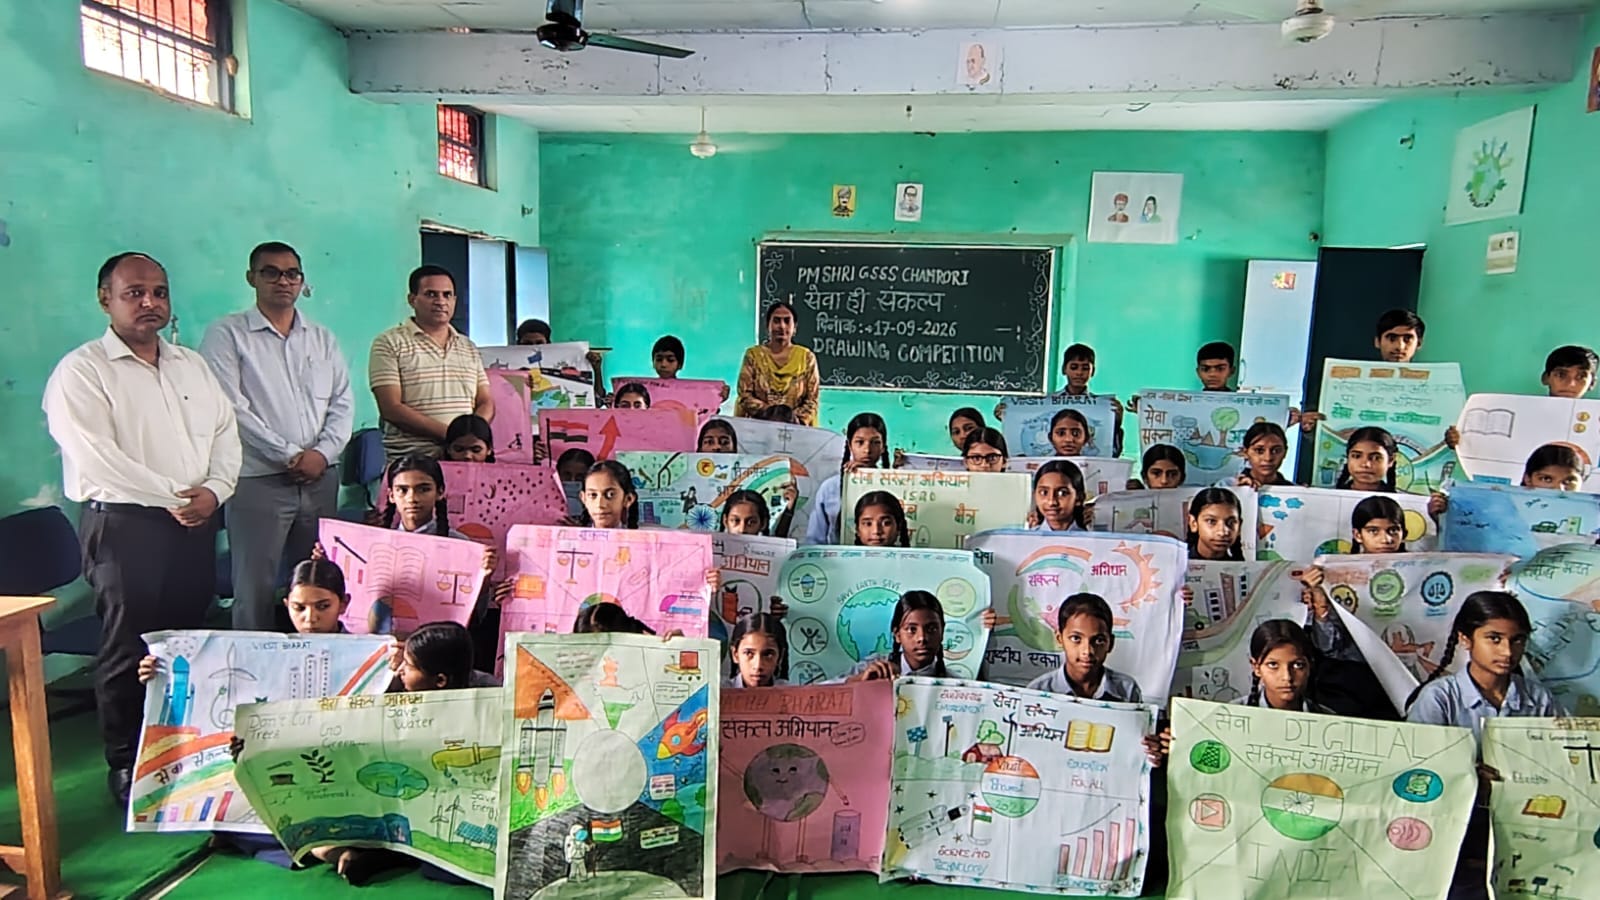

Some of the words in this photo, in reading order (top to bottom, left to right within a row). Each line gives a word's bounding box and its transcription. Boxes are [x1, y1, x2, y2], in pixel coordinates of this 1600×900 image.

[797, 267, 820, 283] PM
[822, 265, 855, 283] SHRI
[858, 265, 899, 282] GSSS
[804, 284, 845, 310] सेवा
[846, 287, 871, 314] ही
[876, 285, 946, 312] संकल्प
[813, 337, 890, 359] DRAWING
[897, 342, 1005, 365] COMPETITION
[1143, 404, 1168, 427] सेवा
[780, 691, 850, 714] BHARAT
[993, 691, 1022, 710] सेवा
[386, 706, 419, 720] Save
[394, 717, 435, 730] Water
[1215, 705, 1251, 734] सेवा
[774, 715, 839, 739] अभियान
[1284, 717, 1429, 762] DIGITAL
[1247, 842, 1361, 885] INDIA
